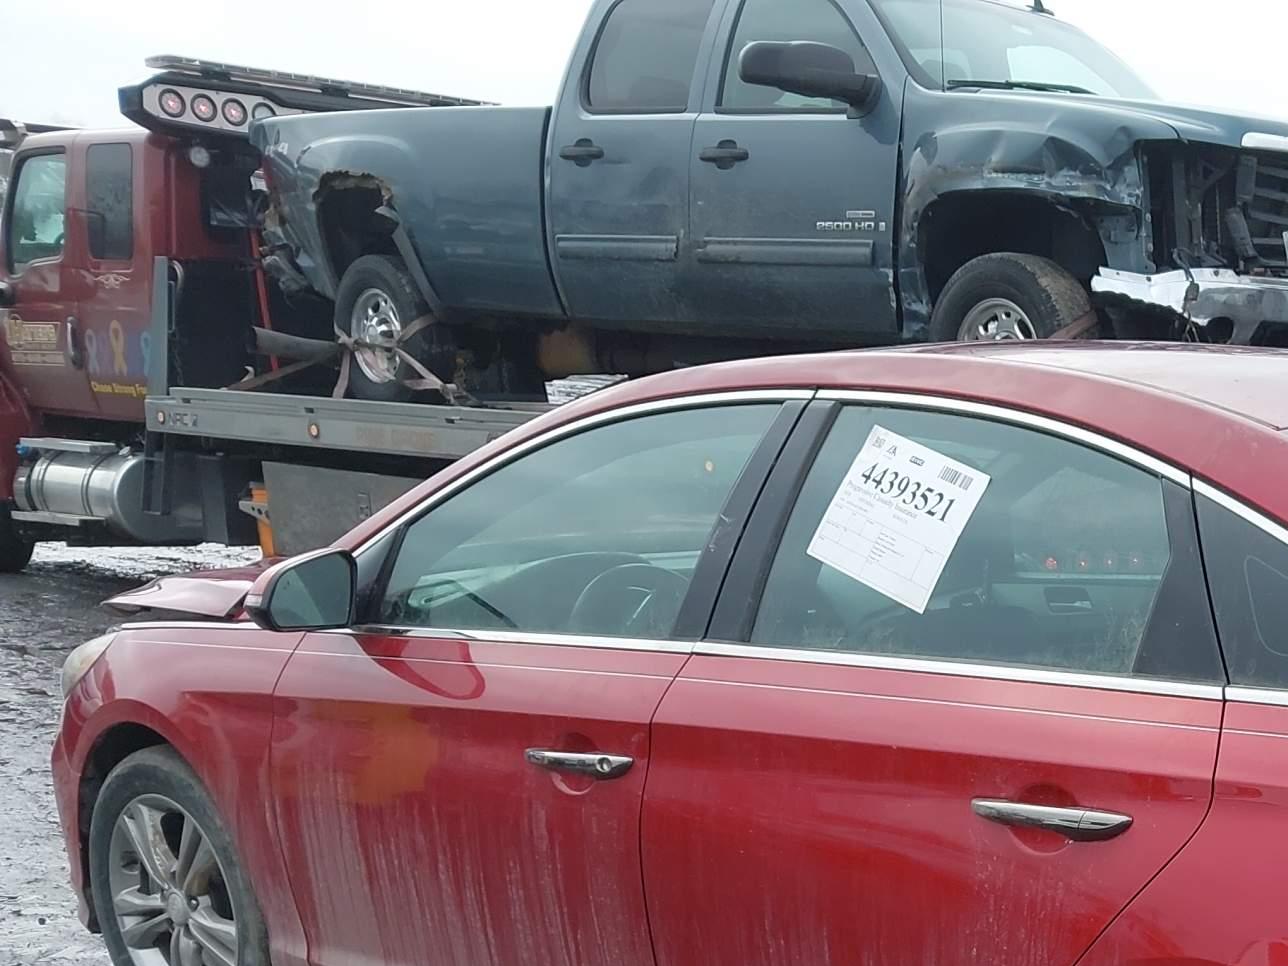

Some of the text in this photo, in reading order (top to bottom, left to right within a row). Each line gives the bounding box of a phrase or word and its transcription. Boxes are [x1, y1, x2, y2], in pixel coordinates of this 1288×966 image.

[816, 221, 875, 231] 2500 HD
[861, 462, 956, 522] 44393521
